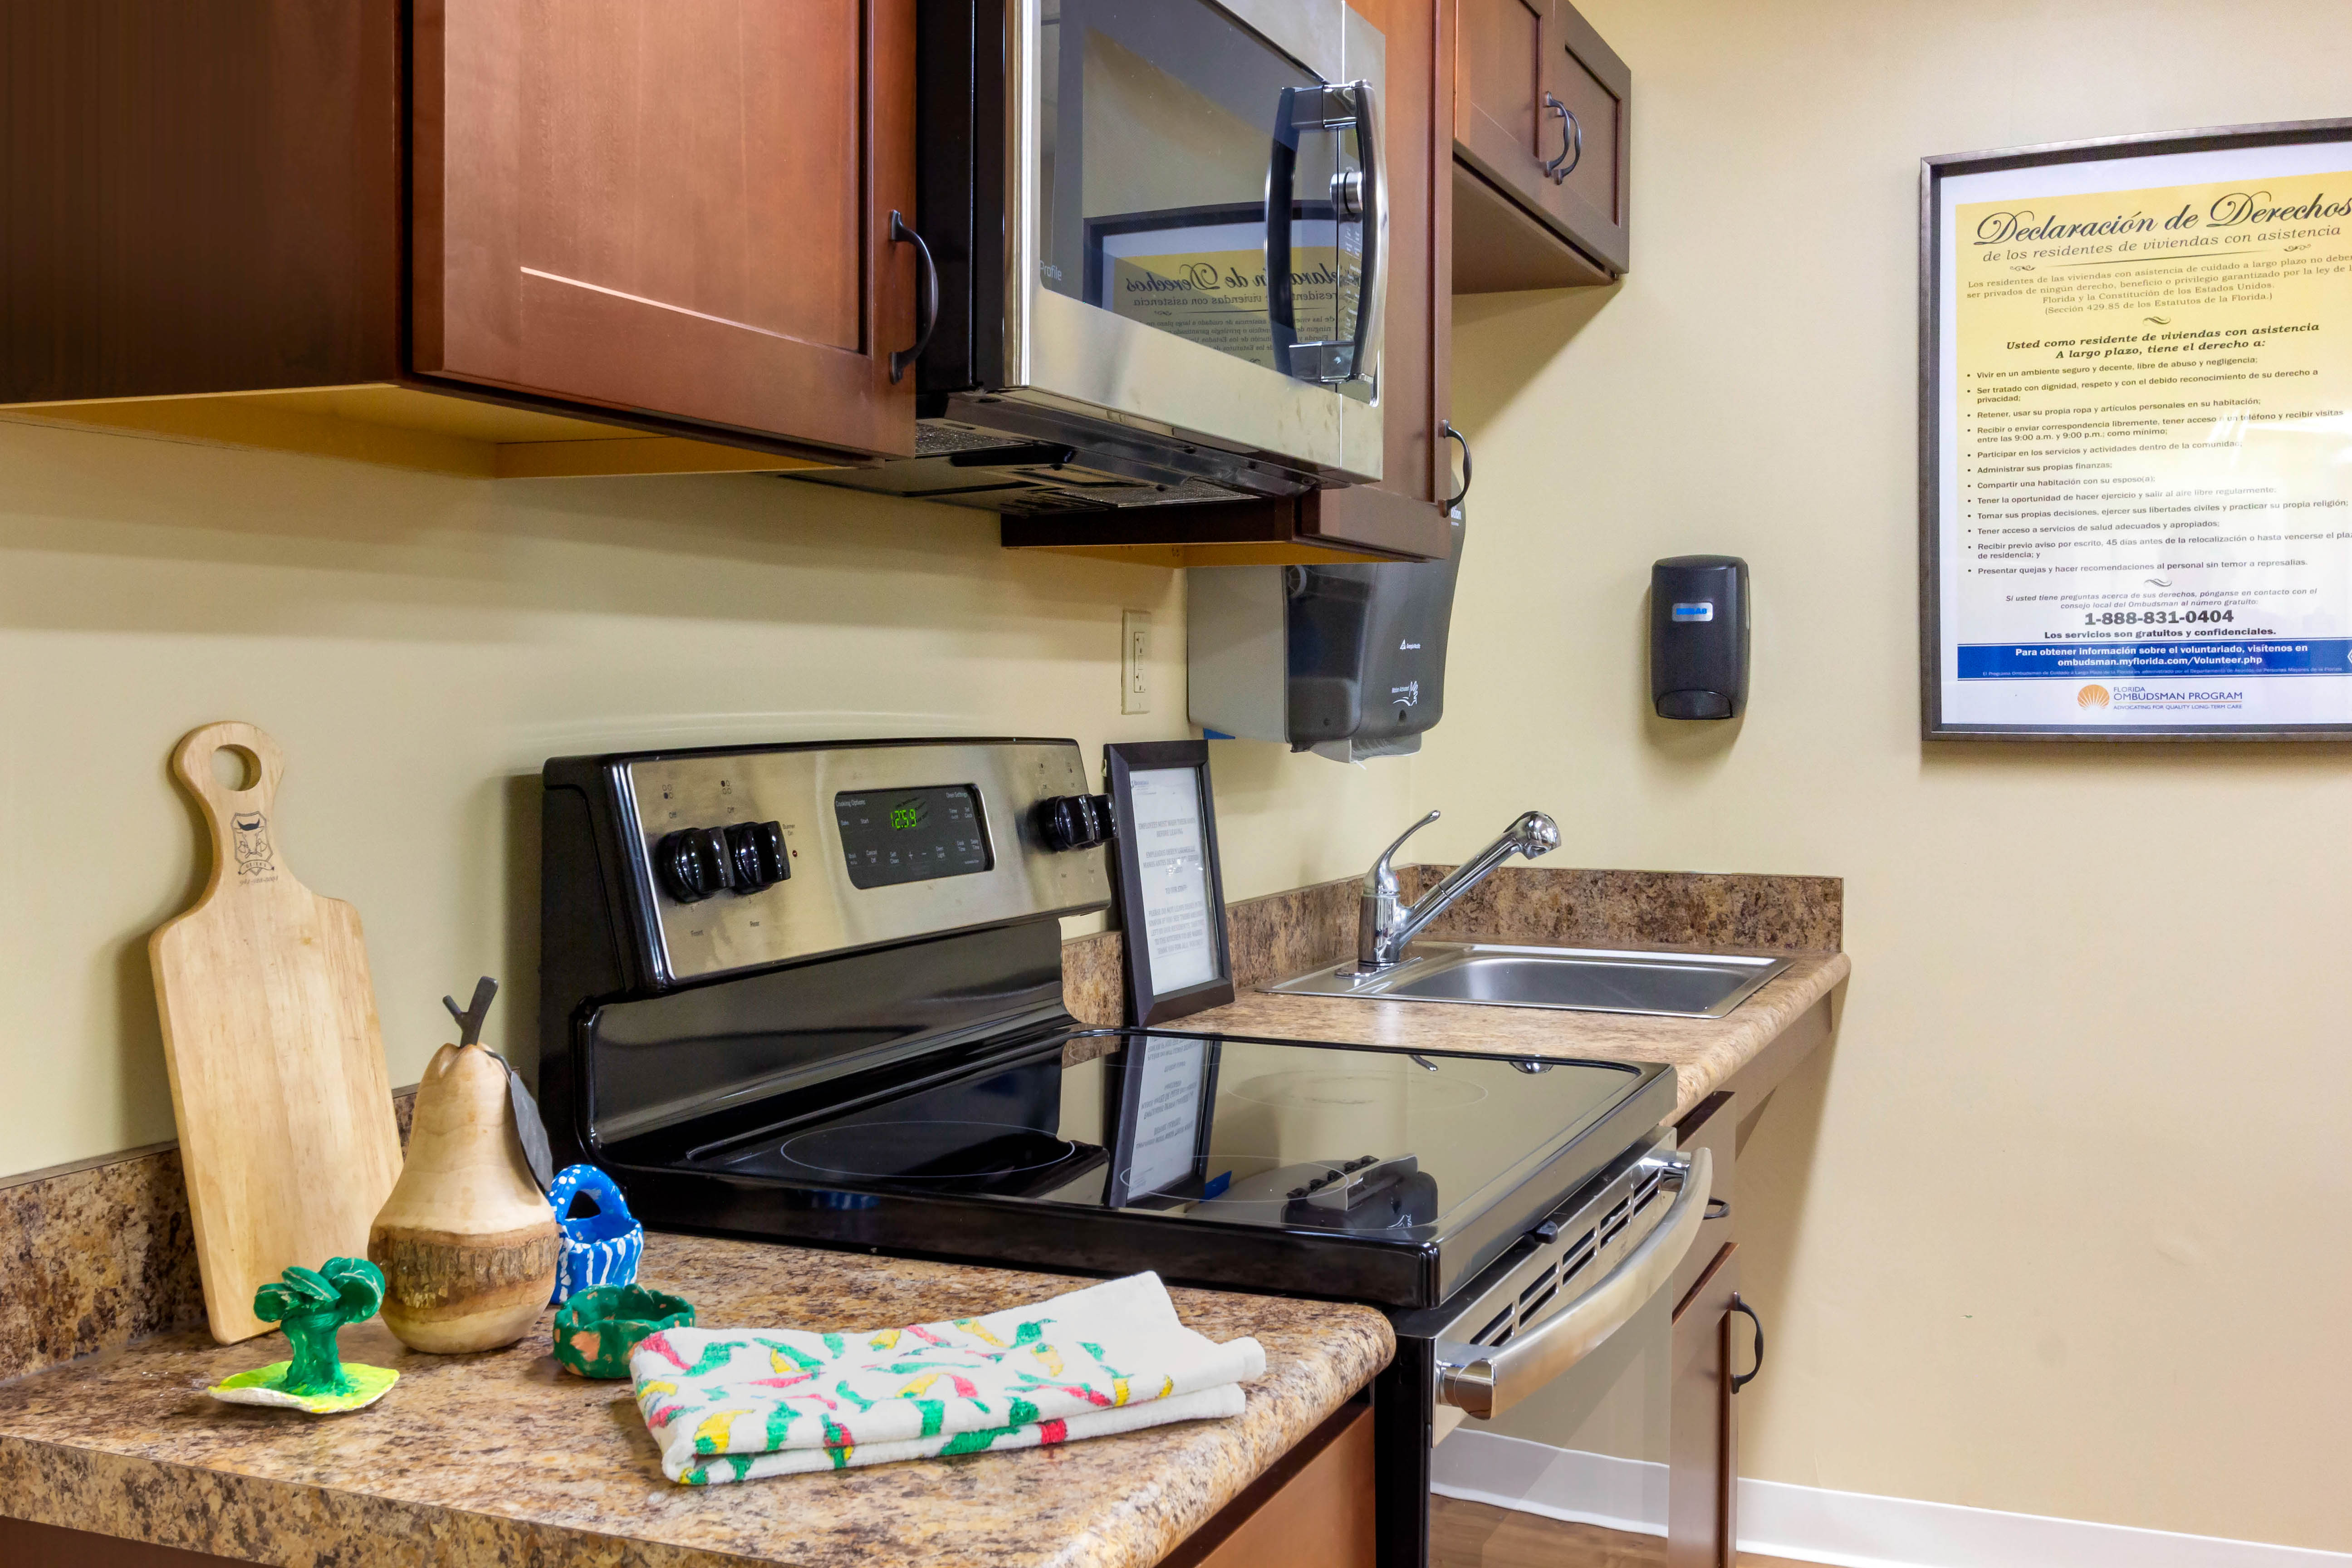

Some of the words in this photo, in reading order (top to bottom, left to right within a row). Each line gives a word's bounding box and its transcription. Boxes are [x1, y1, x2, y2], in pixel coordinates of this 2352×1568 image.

[1974, 211, 2158, 245] Declaración
[2164, 204, 2199, 230] de
[2206, 191, 2352, 227] Derechos
[1983, 251, 2001, 262] de
[2006, 250, 2027, 260] los
[2034, 245, 2112, 258] residentes
[2118, 240, 2137, 252] de
[2143, 235, 2219, 250] viviendas
[2225, 234, 2250, 244] con
[2258, 225, 2340, 241] asistencia
[1039, 260, 1062, 281] Profile
[2043, 295, 2075, 304] Florida
[2099, 290, 2160, 300] Constitución
[2195, 284, 2234, 294] Estados
[2007, 339, 2040, 350] Usted
[2044, 339, 2076, 348] como
[2080, 335, 2138, 345] residente
[2141, 333, 2156, 341] de
[2161, 329, 2221, 340] viviendas
[2252, 323, 2319, 335] asistencia
[2055, 351, 2064, 359] A
[2069, 350, 2101, 359] largo
[2104, 347, 2142, 358] plazo,
[2148, 344, 2179, 353] tiene
[2182, 343, 2194, 351] el
[2198, 340, 2249, 350] derecho
[1993, 385, 2022, 393] tratado
[2180, 373, 2246, 383] reconocimiento
[2274, 369, 2310, 377] derecho
[2045, 408, 2071, 416] propia
[2139, 402, 2185, 412] personales
[2043, 464, 2073, 472] propias
[2019, 566, 2046, 574] quejas
[2081, 564, 2155, 572] recomendaciones
[2167, 561, 2204, 570] personal
[2085, 609, 2234, 625] 1-888-831-0404
[2135, 629, 2183, 639] gratuitos
[2194, 627, 2276, 636] confidenciales.
[2039, 647, 2077, 656] obtener
[2079, 646, 2136, 655] información
[2139, 646, 2166, 654] sobre
[2169, 646, 2178, 654] el
[2180, 645, 2245, 654] voluntariado,
[2247, 644, 2293, 653] visítenos
[2058, 656, 2262, 666] ombudsman.myflorida.com/Volunteer.php
[2113, 692, 2185, 701] OMBUDSMAN
